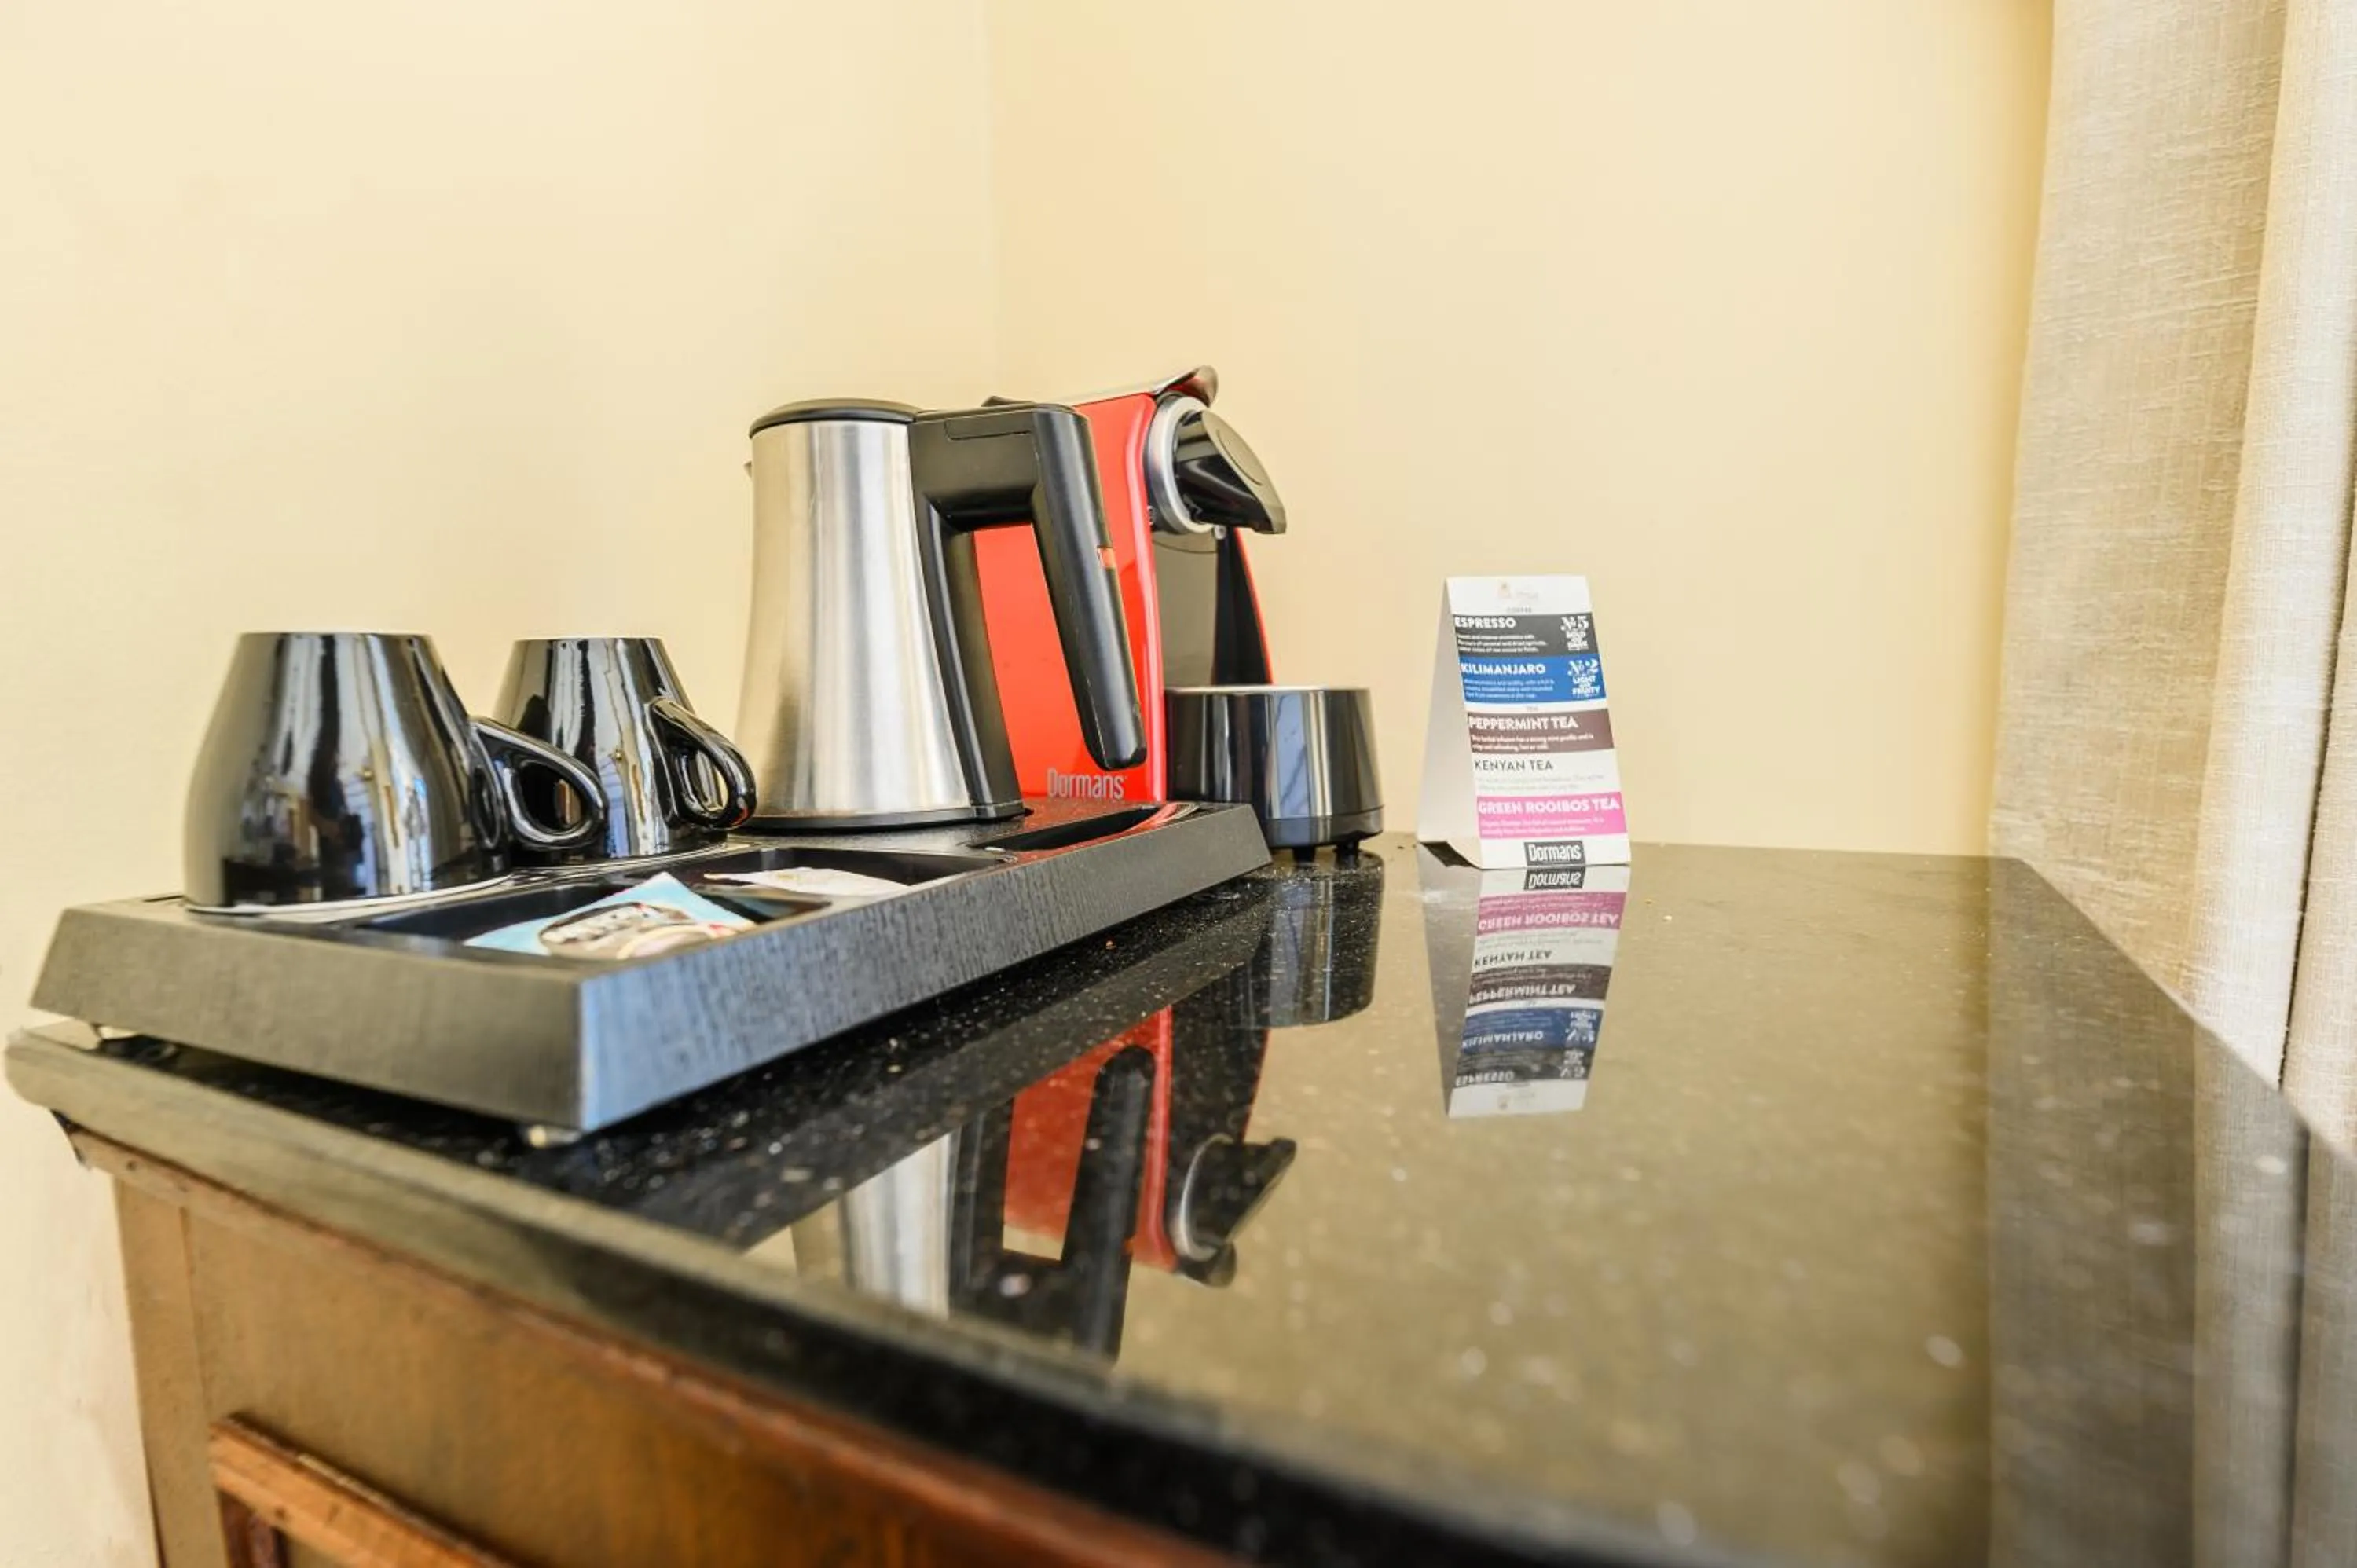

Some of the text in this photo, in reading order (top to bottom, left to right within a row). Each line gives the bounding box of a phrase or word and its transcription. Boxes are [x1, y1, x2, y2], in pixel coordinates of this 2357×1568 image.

[1454, 617, 1516, 629] ESPRESSO
[1461, 663, 1546, 676] KILIMANJARO
[1469, 716, 1578, 731] PEPPERMINT TEA
[1474, 760, 1553, 771] KENYAN TEA
[1047, 768, 1125, 799] Dormans
[1478, 797, 1619, 815] GREEN ROOIBOS TEA
[1528, 844, 1582, 861] Dormans
